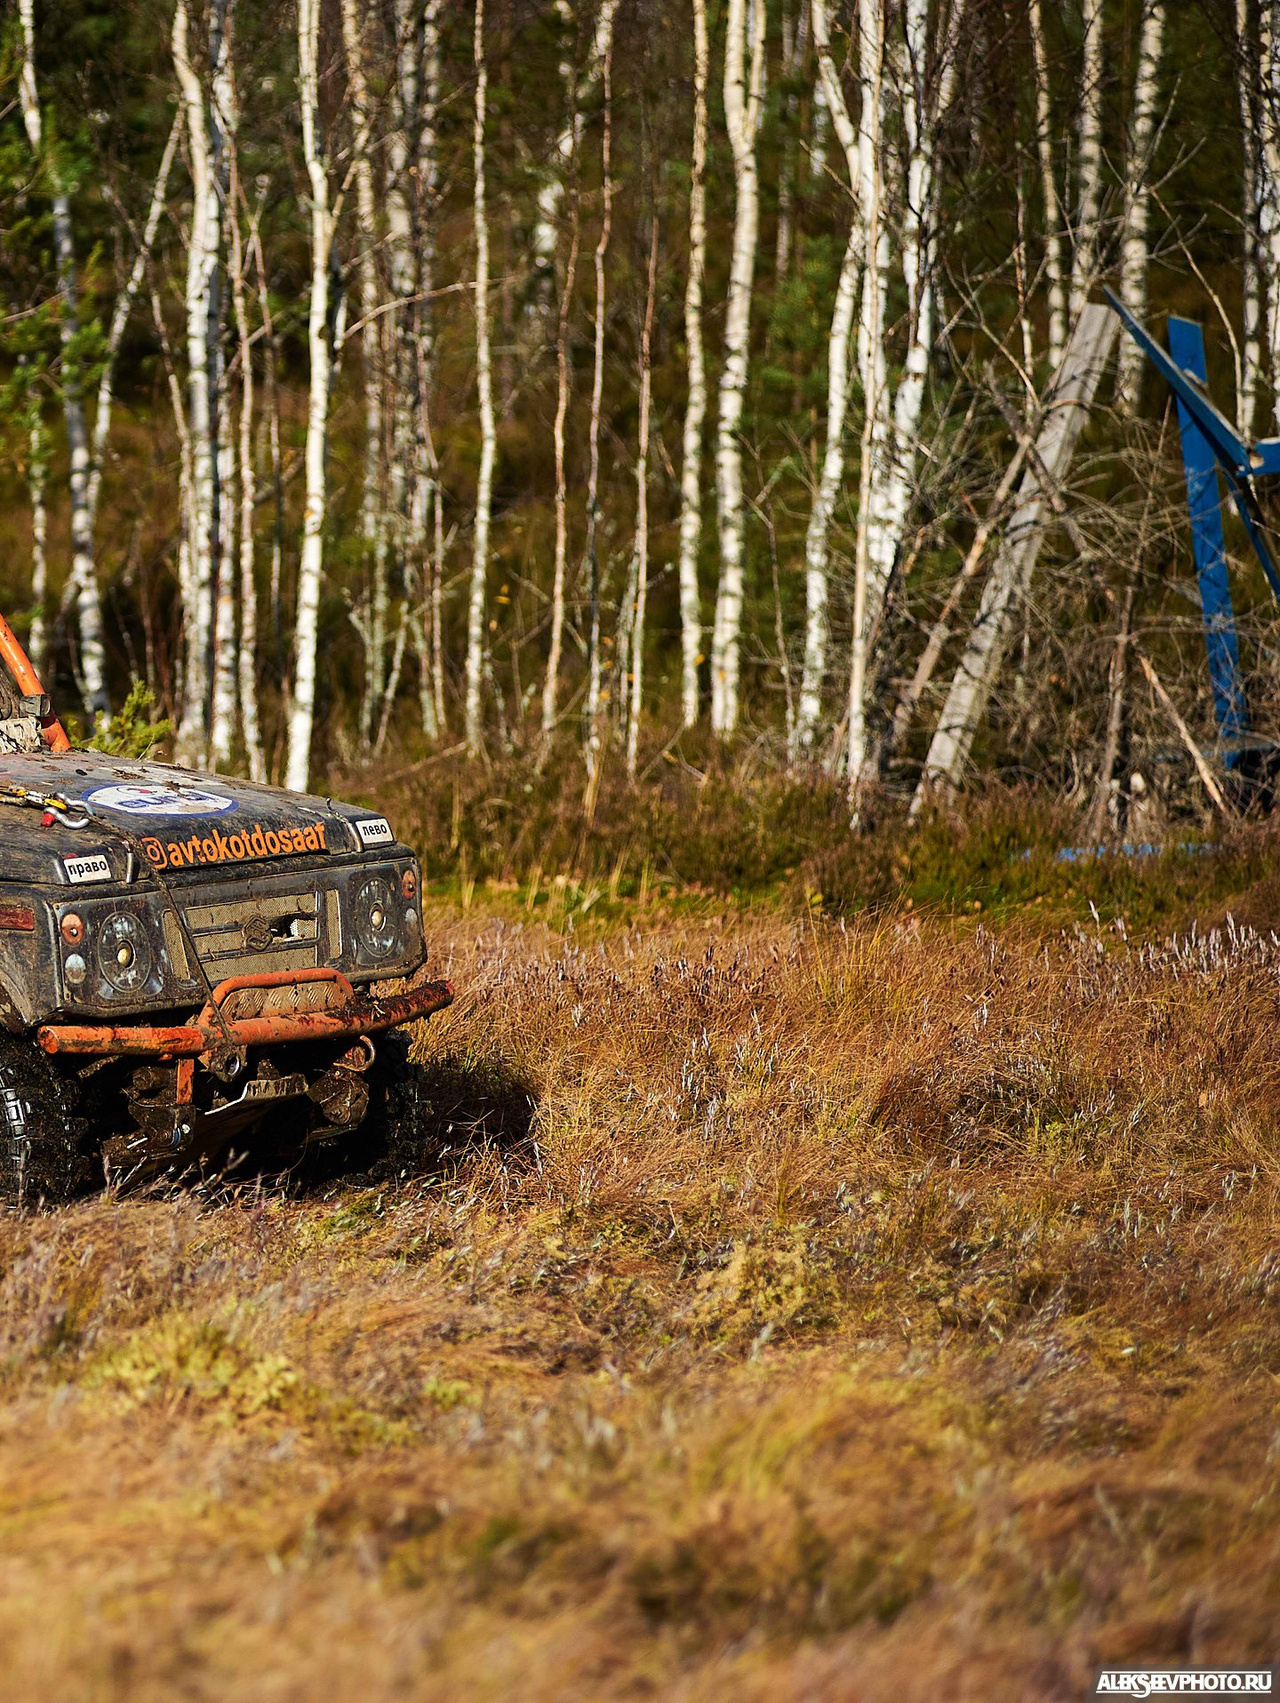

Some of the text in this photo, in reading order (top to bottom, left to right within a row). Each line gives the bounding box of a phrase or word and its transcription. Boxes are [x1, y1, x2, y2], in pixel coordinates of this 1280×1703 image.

[361, 823, 388, 837] лево
[166, 821, 326, 868] avtokotdosaaf
[67, 860, 108, 876] право
